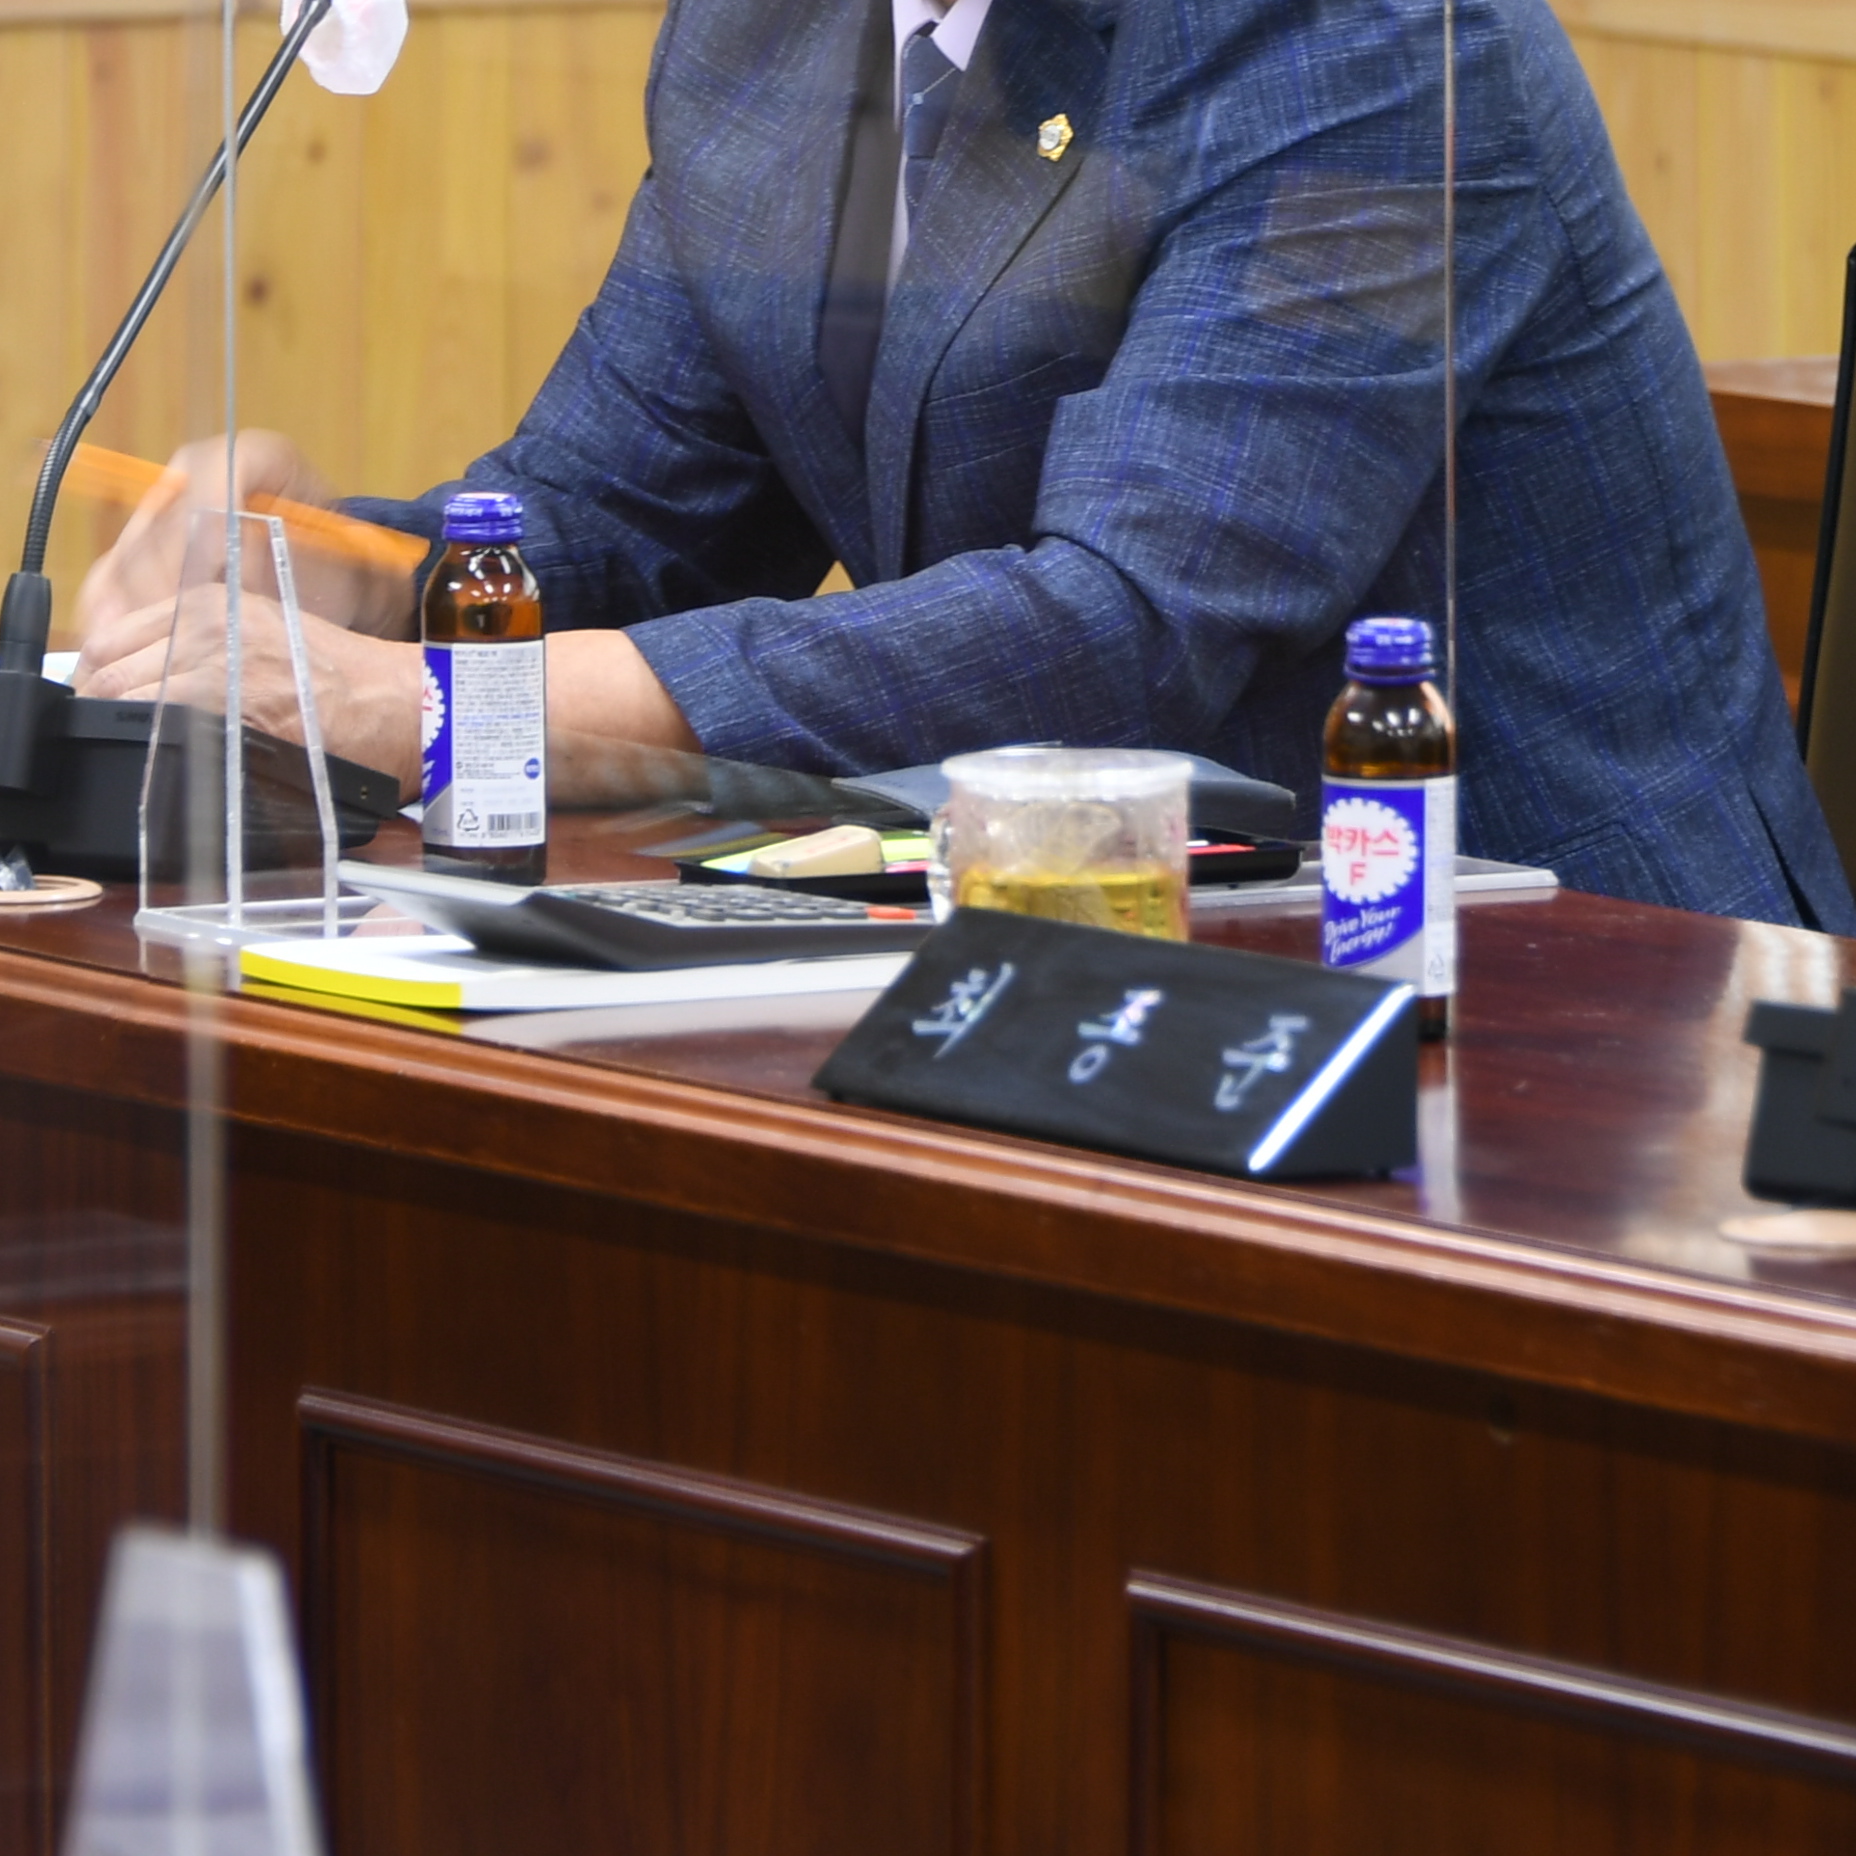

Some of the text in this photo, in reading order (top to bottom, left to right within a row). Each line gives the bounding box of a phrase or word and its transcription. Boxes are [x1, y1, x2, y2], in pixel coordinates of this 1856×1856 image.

[1326, 825, 1400, 856] 박카스
[1349, 861, 1367, 886] F
[1360, 905, 1403, 930] Your
